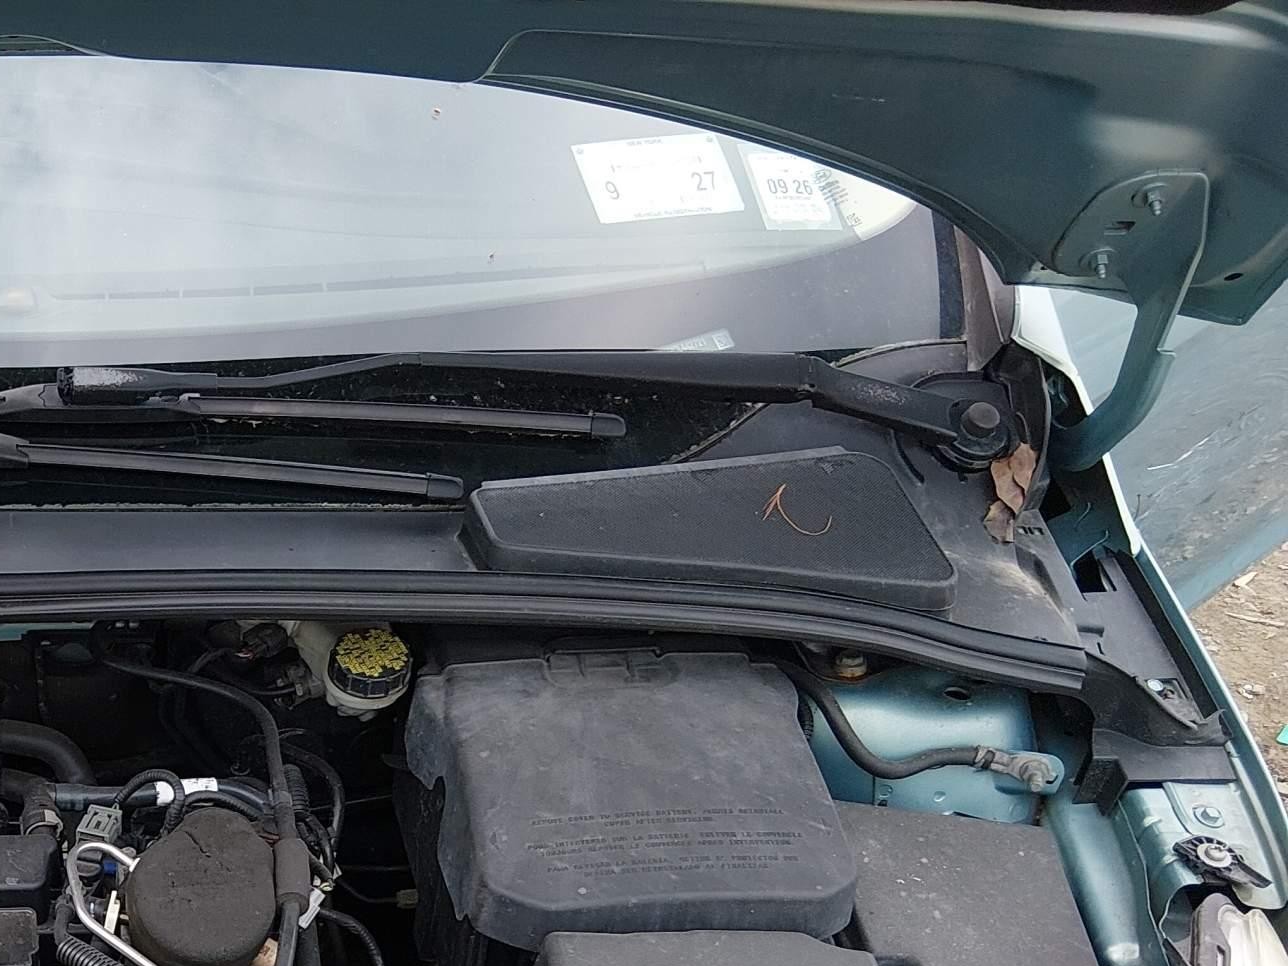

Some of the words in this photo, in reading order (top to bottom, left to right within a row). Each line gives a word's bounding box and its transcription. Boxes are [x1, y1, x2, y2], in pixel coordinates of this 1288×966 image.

[605, 180, 620, 200] 9
[691, 171, 716, 191] 27
[768, 178, 788, 194] 09
[792, 180, 813, 195] 26
